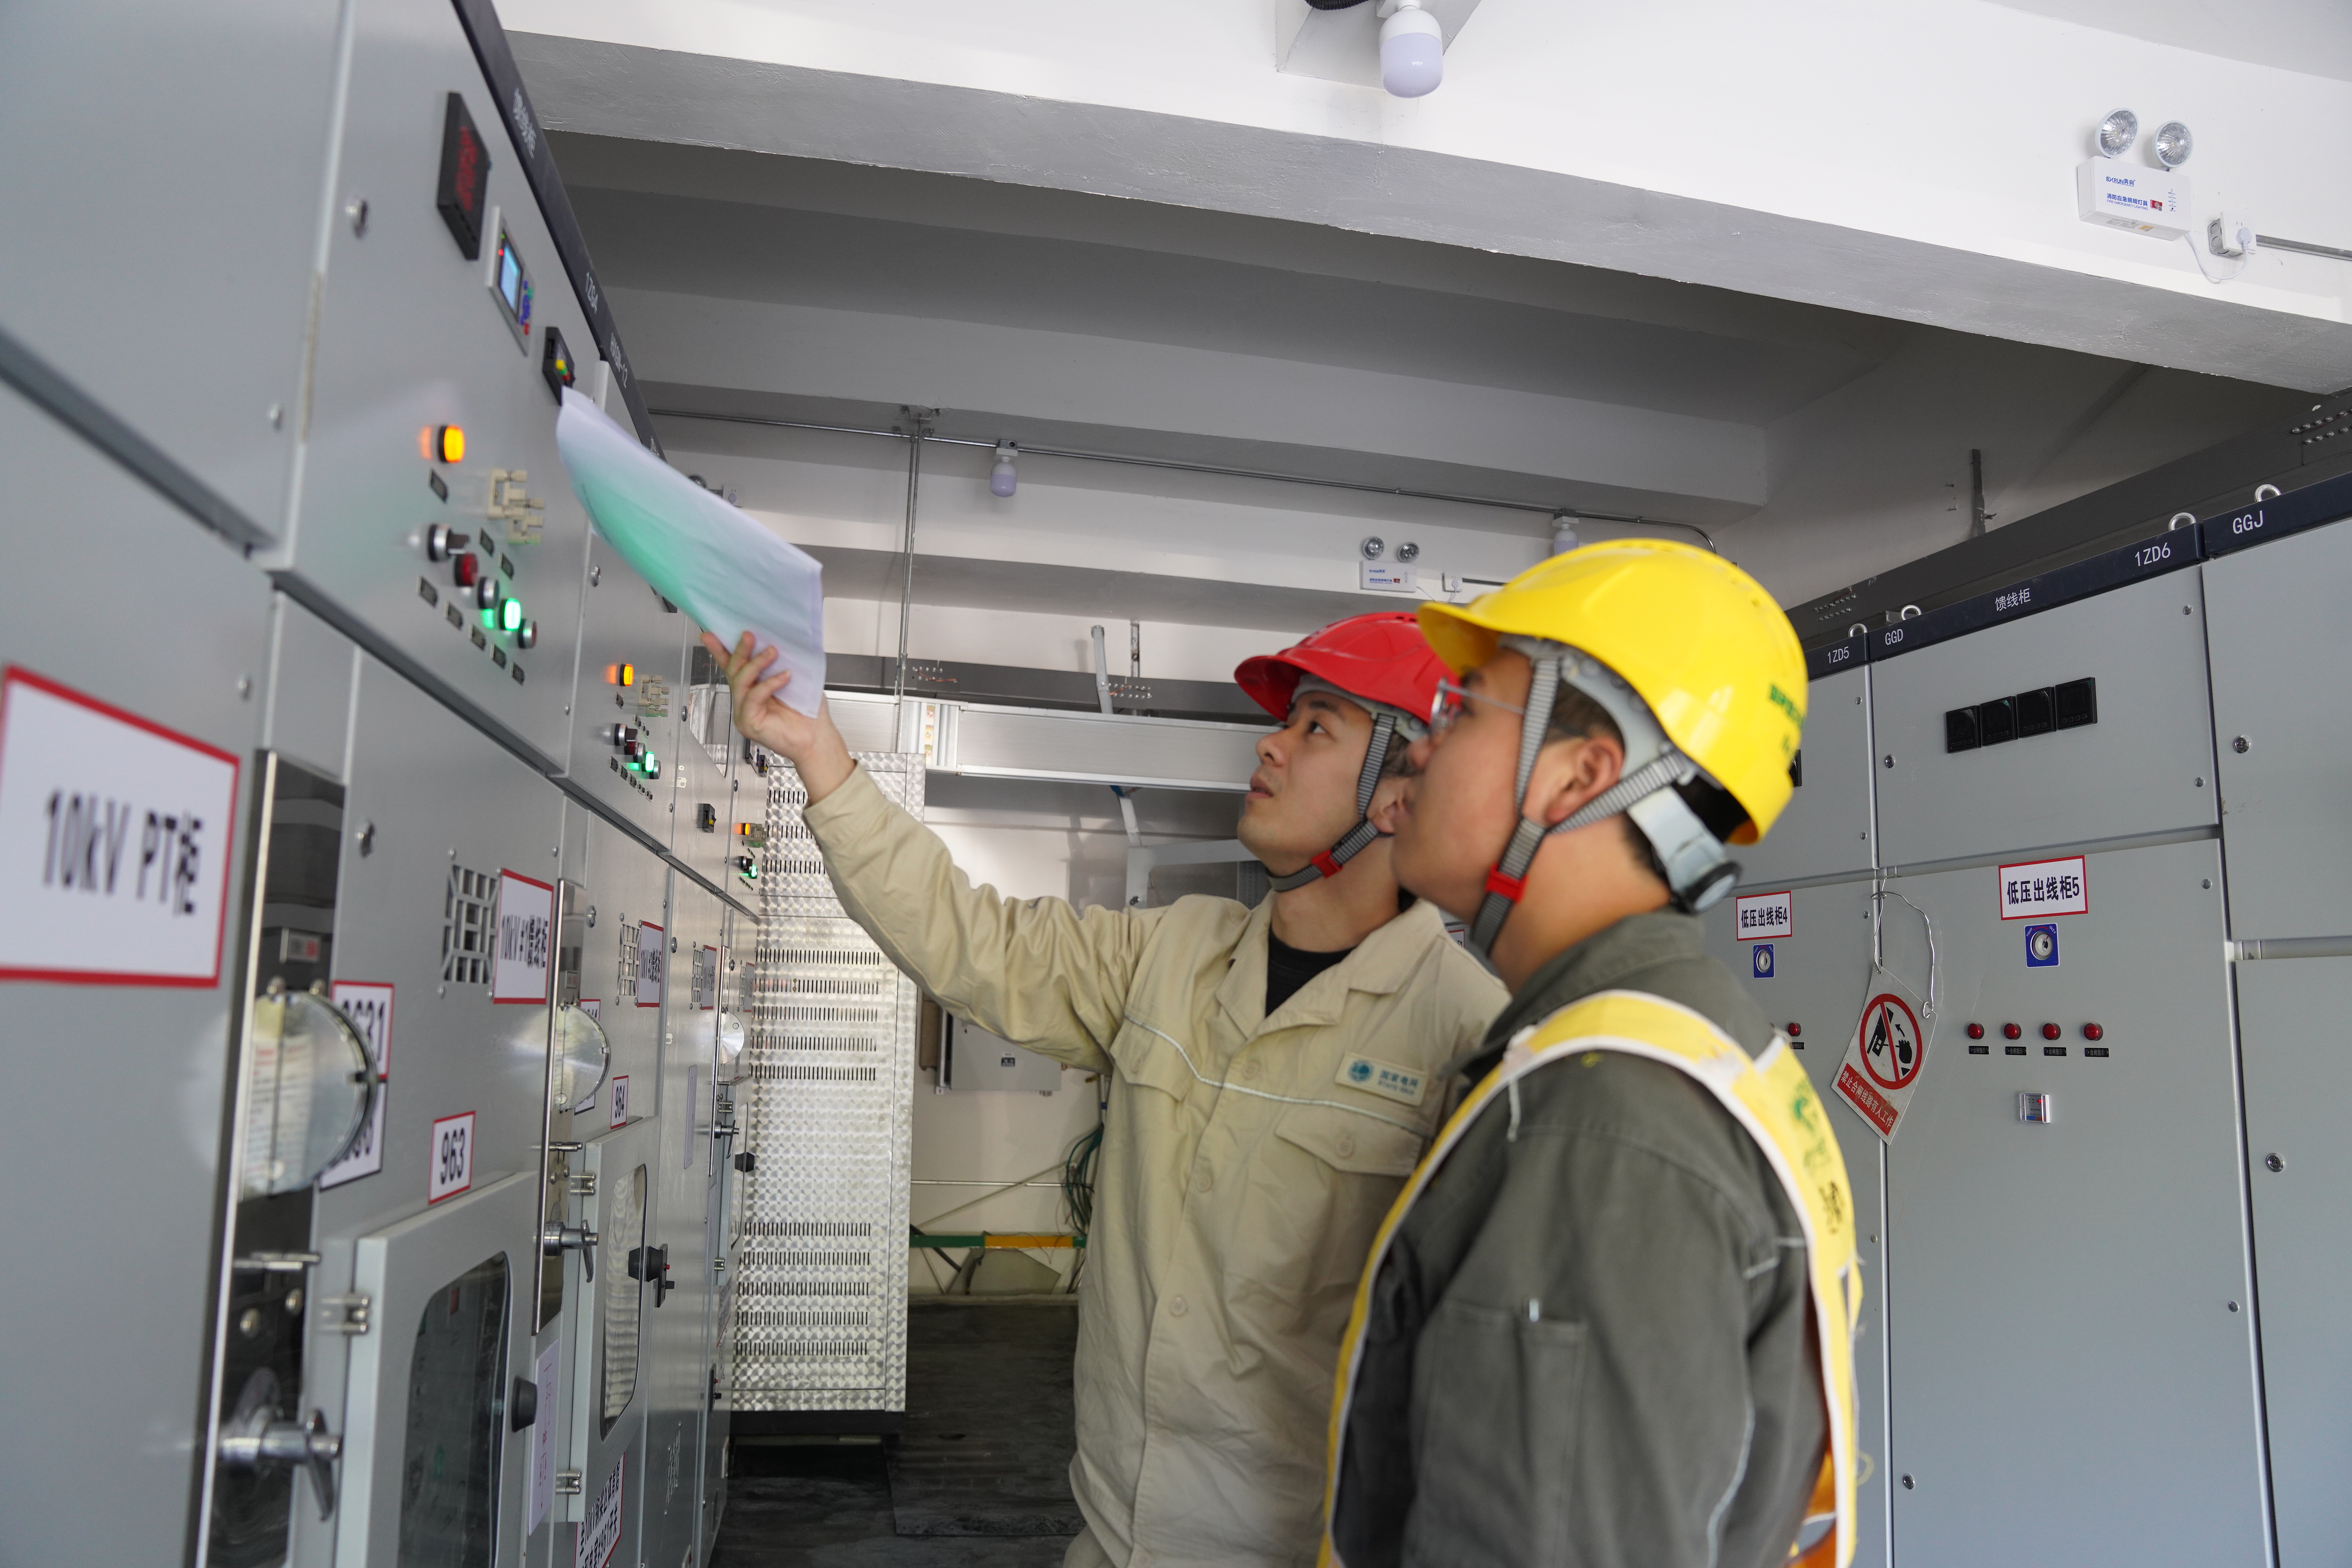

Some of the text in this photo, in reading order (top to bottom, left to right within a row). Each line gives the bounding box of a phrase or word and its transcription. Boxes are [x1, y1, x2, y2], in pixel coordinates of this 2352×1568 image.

[2107, 193, 2148, 206] 消防应急照明灯具
[2233, 510, 2263, 534] GGJ
[2135, 542, 2171, 567] 1ZD6
[1995, 588, 2031, 611] 馈线柜
[1885, 629, 1904, 645] GGD
[1827, 646, 1850, 664] 1ZD5
[44, 787, 131, 896] 10kV
[2007, 876, 2080, 905] 低压出线柜5
[1741, 906, 1788, 929] 低压出线柜4
[615, 1085, 625, 1119] 964
[1841, 1071, 1894, 1127] 禁止合闸线路有人工作
[440, 1127, 466, 1185] 963
